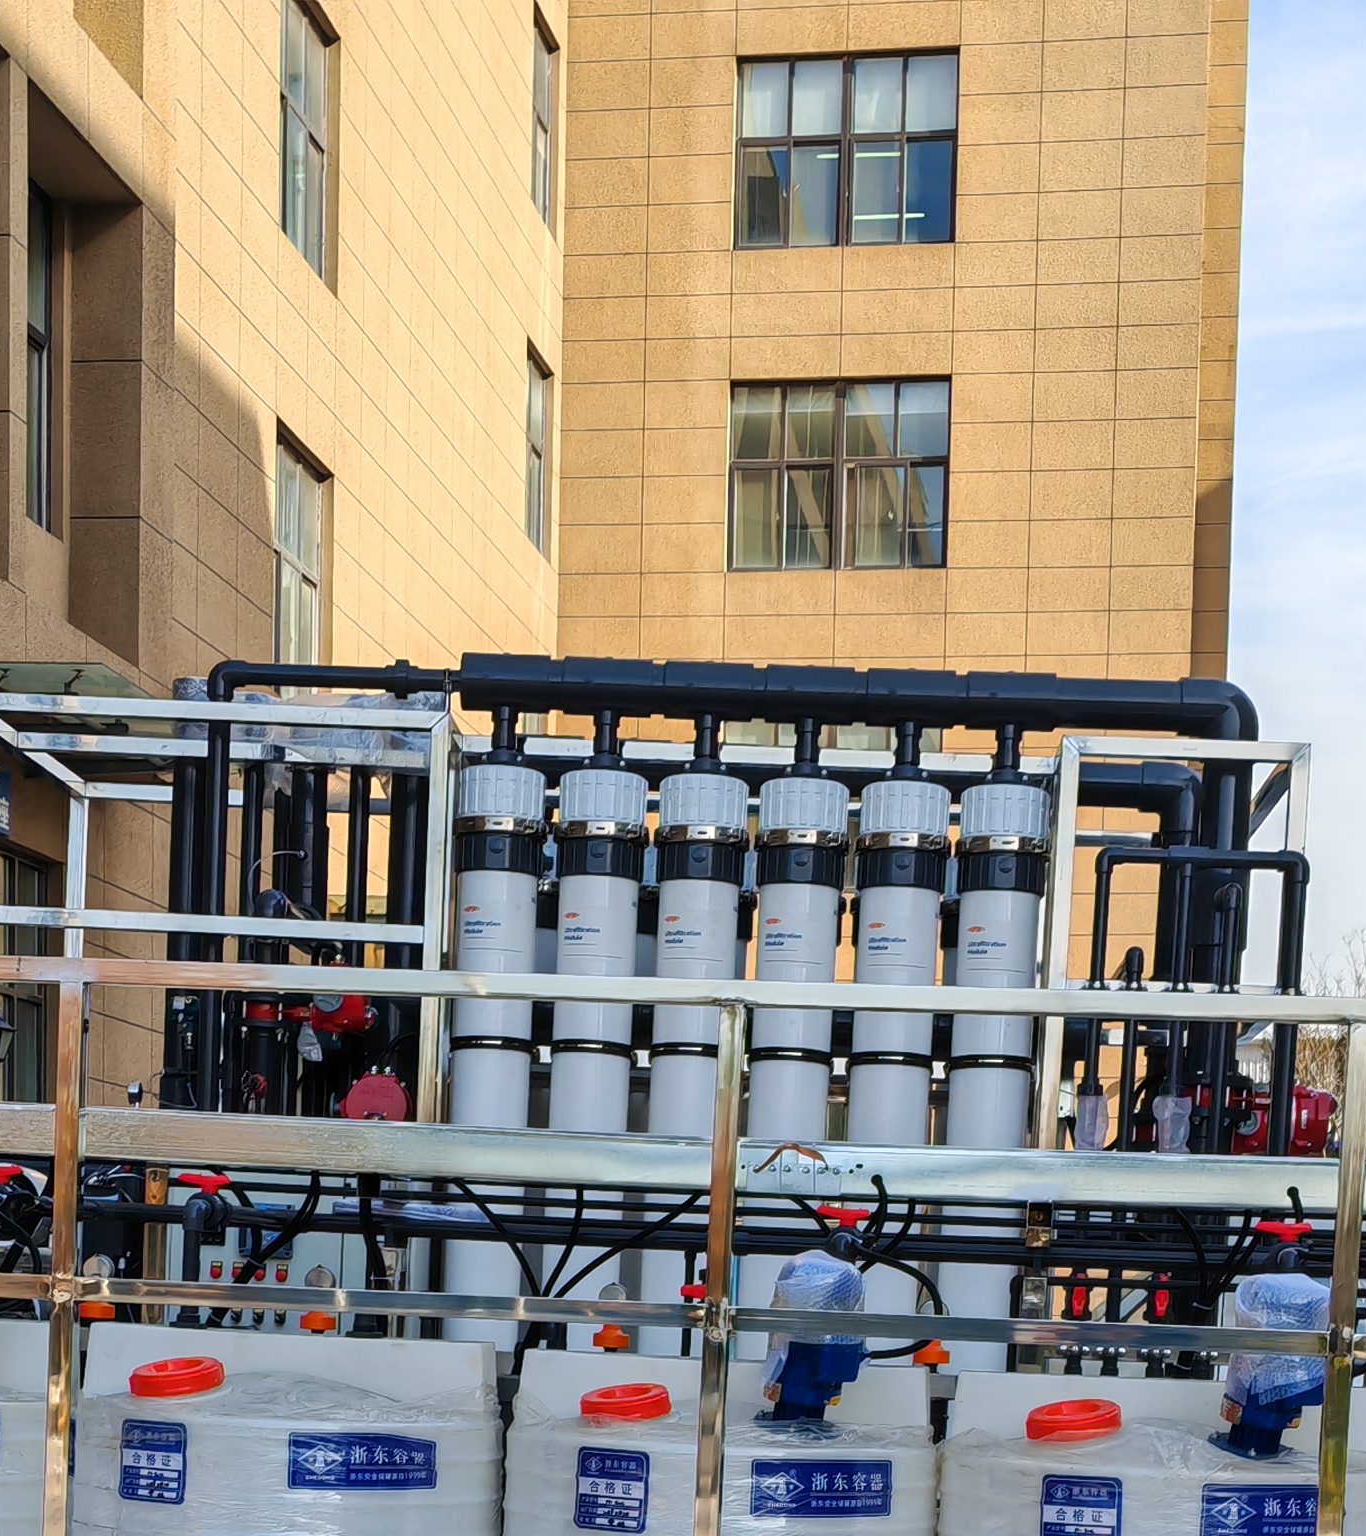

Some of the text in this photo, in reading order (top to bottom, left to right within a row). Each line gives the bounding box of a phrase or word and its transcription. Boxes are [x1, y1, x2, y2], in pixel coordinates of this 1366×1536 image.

[132, 1452, 171, 1467] 合格证
[589, 1480, 632, 1496] 合格证
[811, 1472, 884, 1491] 浙东容器
[1263, 1497, 1318, 1517] 浙东容
[1055, 1508, 1103, 1523] 合格证
